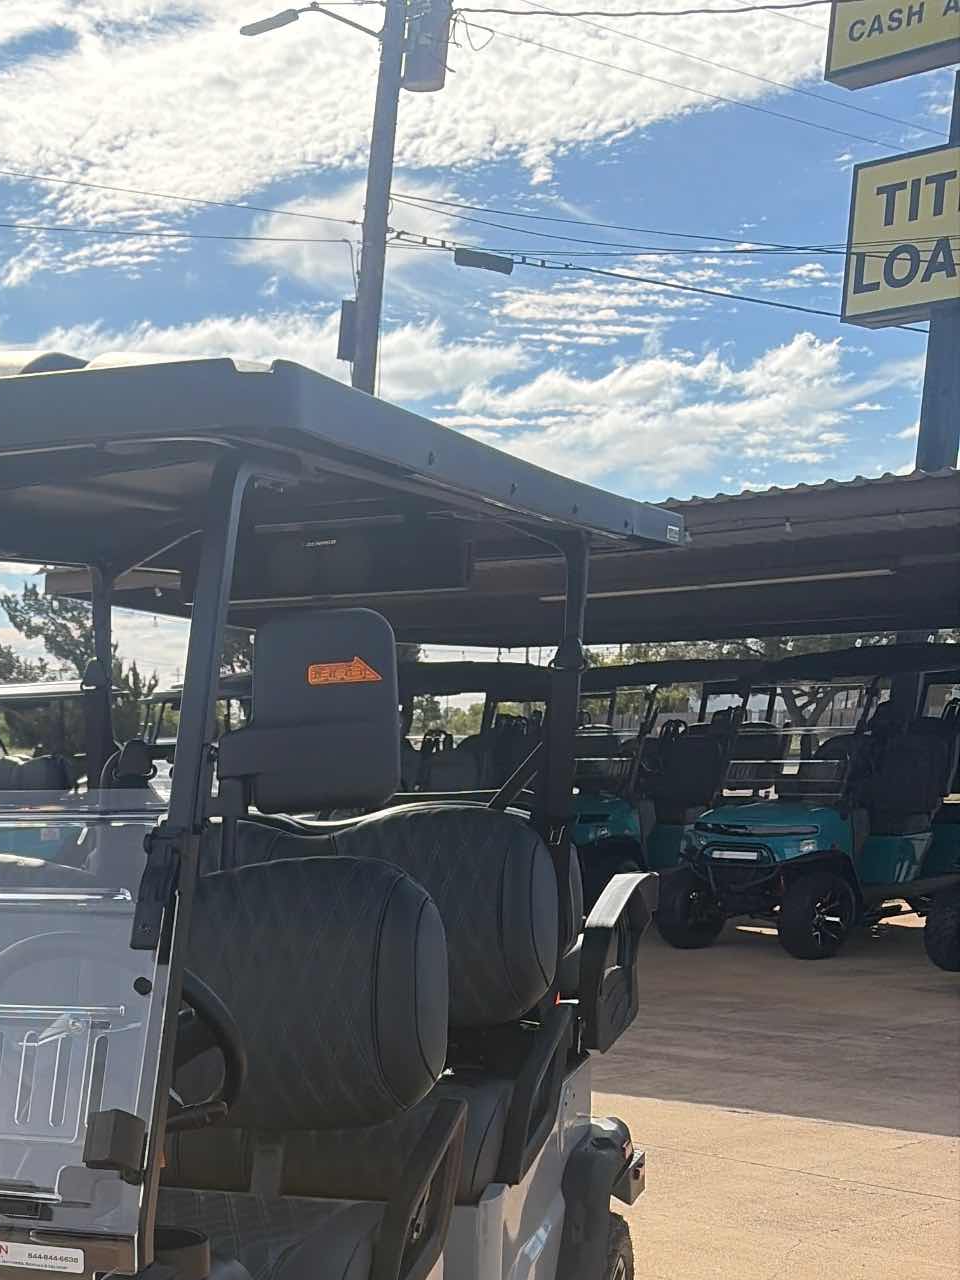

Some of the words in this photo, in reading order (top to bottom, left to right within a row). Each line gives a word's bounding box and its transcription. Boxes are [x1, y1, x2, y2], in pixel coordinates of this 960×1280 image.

[848, 1, 925, 42] CASH
[876, 170, 960, 227] TIT
[853, 236, 958, 295] LOA
